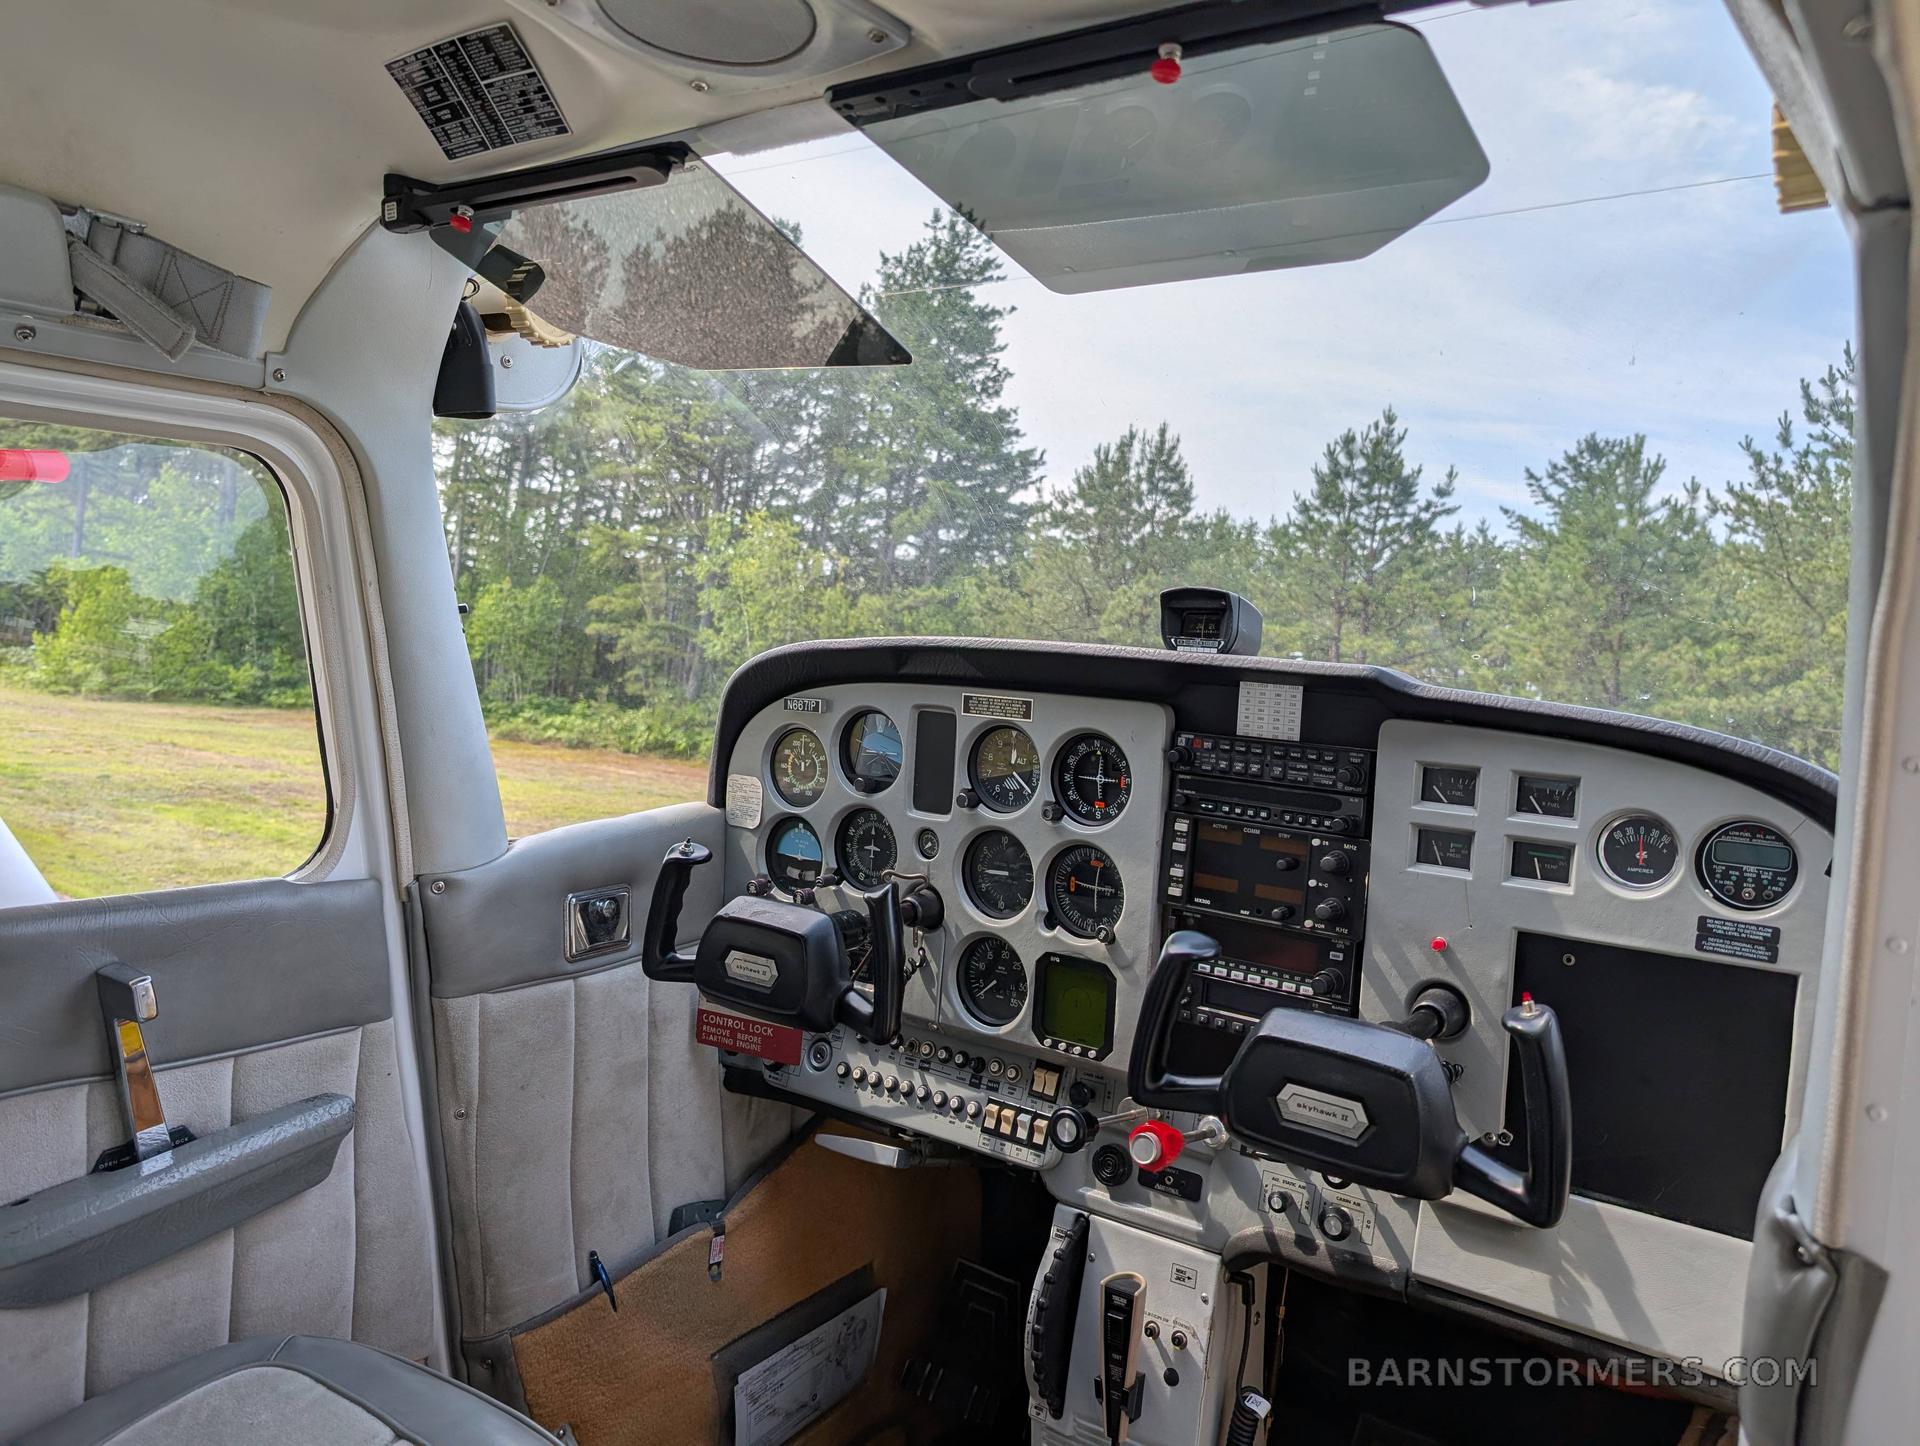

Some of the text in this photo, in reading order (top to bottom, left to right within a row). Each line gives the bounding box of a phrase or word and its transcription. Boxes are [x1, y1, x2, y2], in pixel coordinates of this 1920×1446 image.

[998, 740, 1003, 748] 9
[1077, 743, 1087, 753] 33
[1094, 740, 1101, 748] N
[988, 753, 994, 761] 8
[1033, 755, 1038, 763] 2
[1067, 755, 1075, 766] 30
[1064, 773, 1071, 782] W
[995, 784, 1001, 793] 6
[1009, 792, 1014, 800] 5
[1095, 811, 1101, 819] S
[1243, 827, 1260, 835] COMM
[1625, 827, 1634, 836] 30
[1640, 826, 1645, 835] 0
[1650, 829, 1660, 838] 30
[1613, 830, 1623, 840] 60
[1662, 835, 1671, 844] 60
[983, 847, 988, 855] 5
[981, 884, 986, 892] 5
[998, 901, 1005, 910] 10
[1744, 929, 1772, 937] DETERMINE
[1731, 940, 1753, 948] ORIGINAL
[1702, 941, 1772, 956] FLOW/PRESSURE INSTRUMENT
[1002, 951, 1010, 959] 20
[1013, 961, 1021, 970] 25
[980, 980, 985, 988] 5
[1010, 999, 1018, 1007] 35
[703, 1014, 774, 1037] CONTROL LOCK
[703, 1025, 762, 1045] REMOVE BEFORE
[736, 1040, 762, 1052] ENGINE
[1297, 1101, 1349, 1122] skyhawk II
[1282, 1180, 1296, 1188] STATIC
[1336, 1196, 1352, 1204] CABIN
